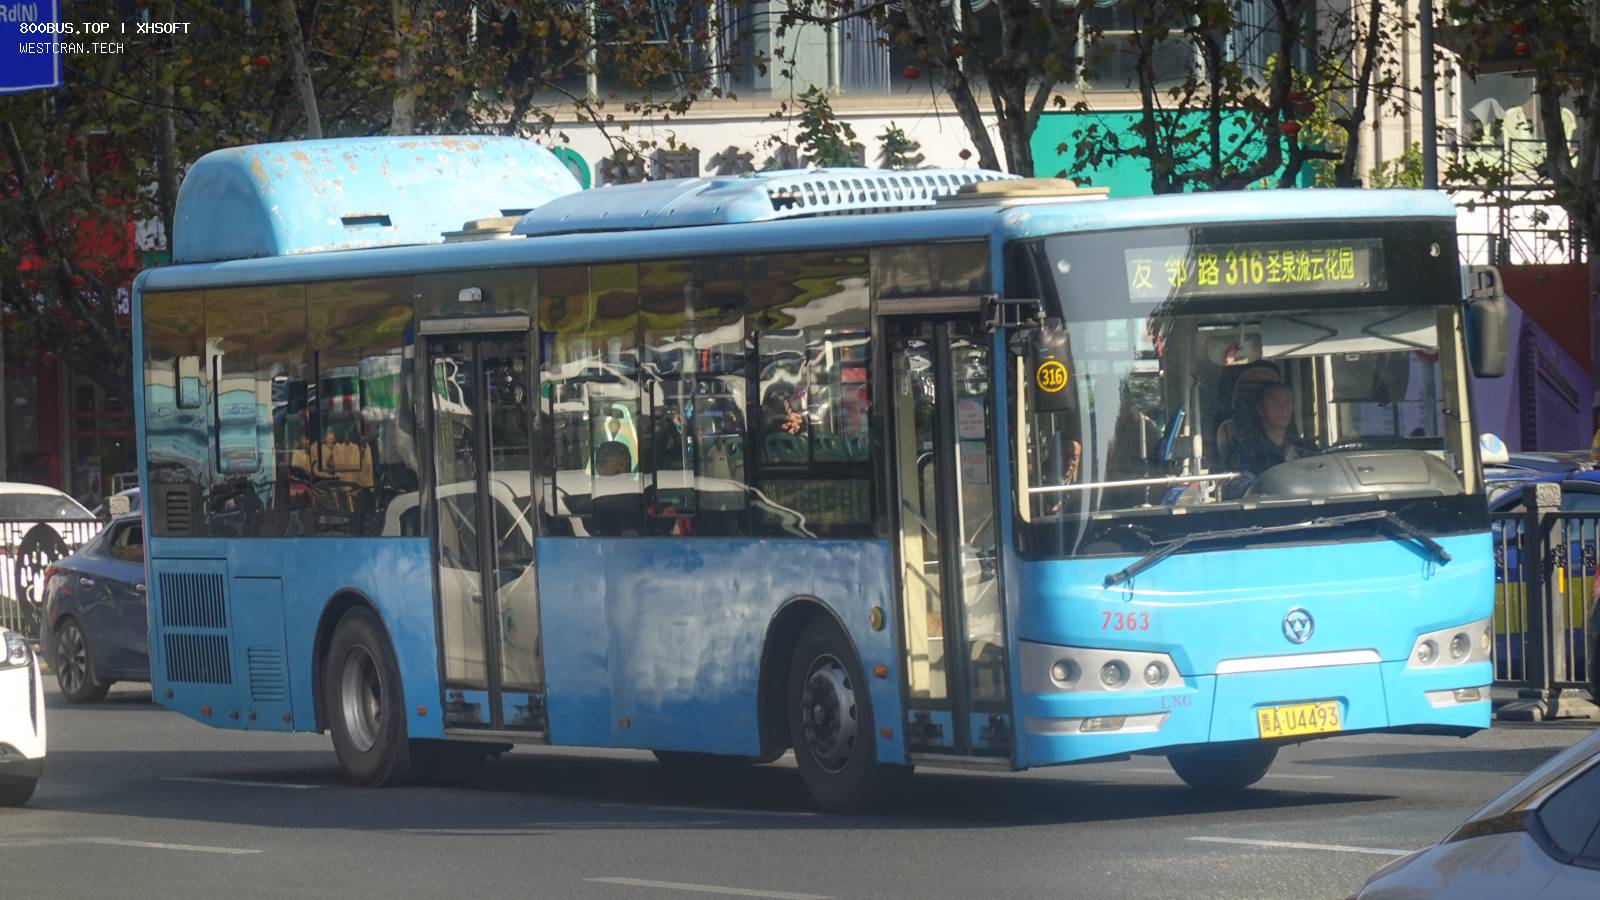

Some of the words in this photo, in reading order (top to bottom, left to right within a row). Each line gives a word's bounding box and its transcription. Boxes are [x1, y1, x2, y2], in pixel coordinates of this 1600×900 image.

[1225, 251, 1263, 285] 316
[1267, 247, 1355, 283] 圣泉流云花园
[1042, 368, 1063, 385] 316
[1101, 611, 1150, 631] 7363
[1161, 695, 1192, 710] LNG
